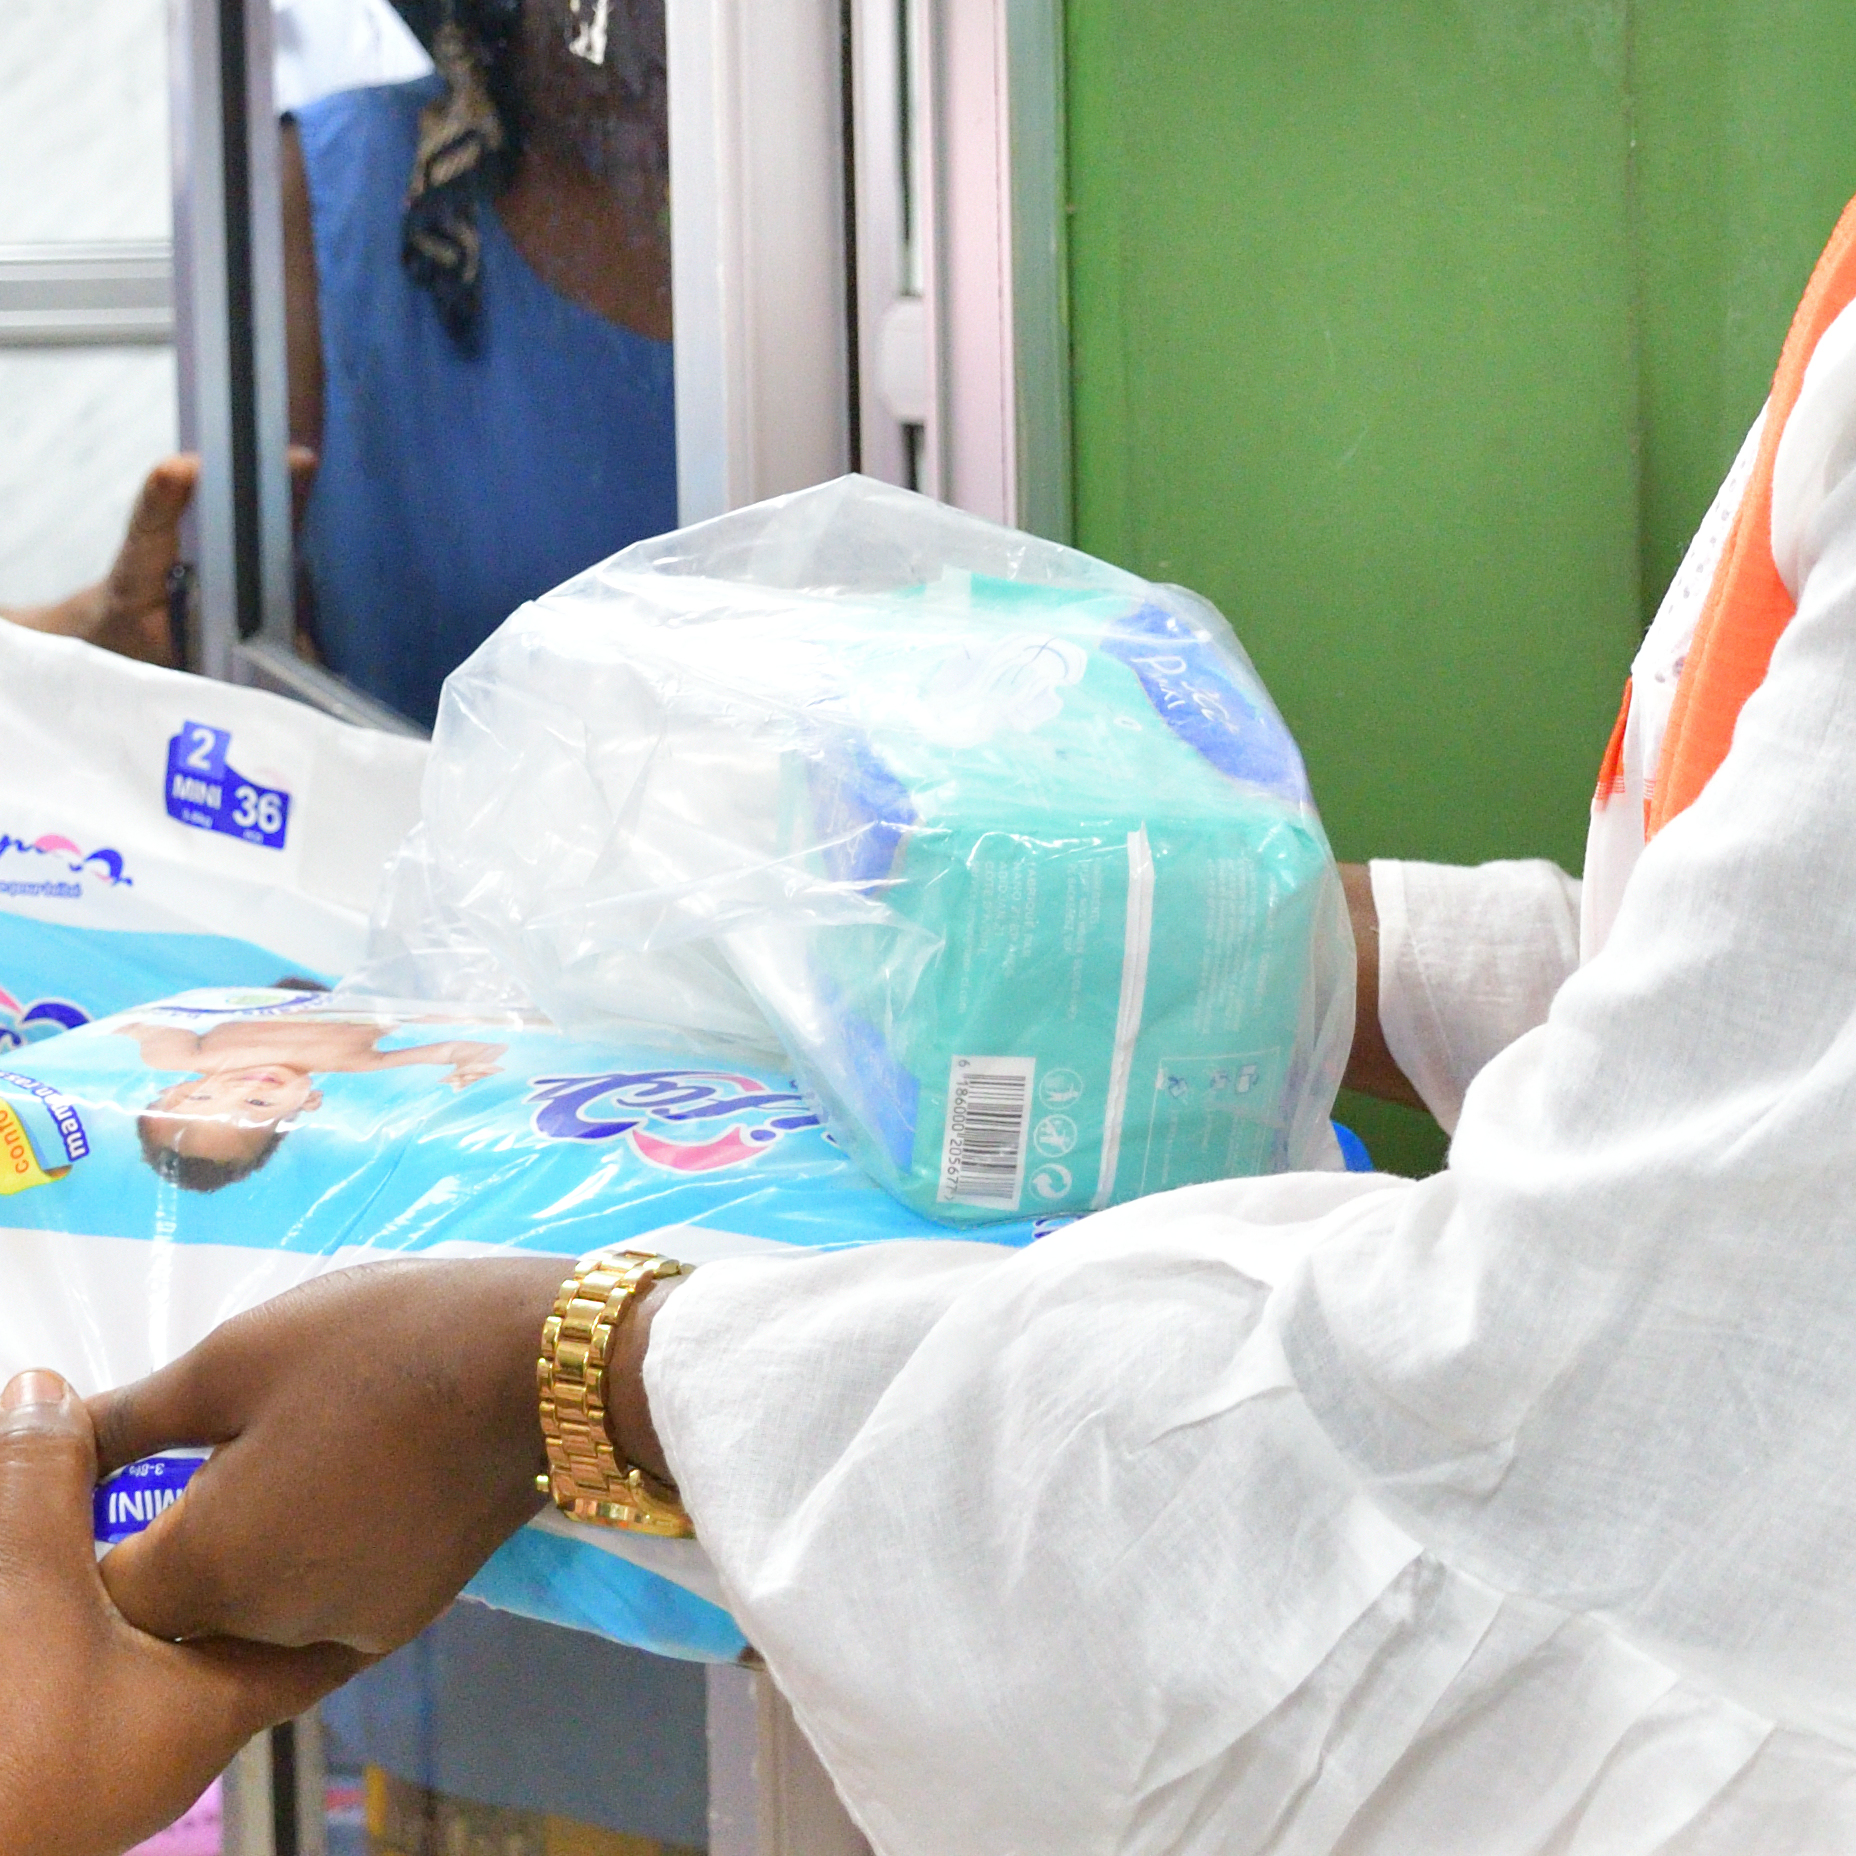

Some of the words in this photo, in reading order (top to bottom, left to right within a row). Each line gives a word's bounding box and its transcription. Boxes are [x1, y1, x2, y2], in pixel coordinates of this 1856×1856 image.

[187, 728, 216, 771] 2
[232, 785, 283, 834] 36
[35, 1087, 90, 1162] mamn
